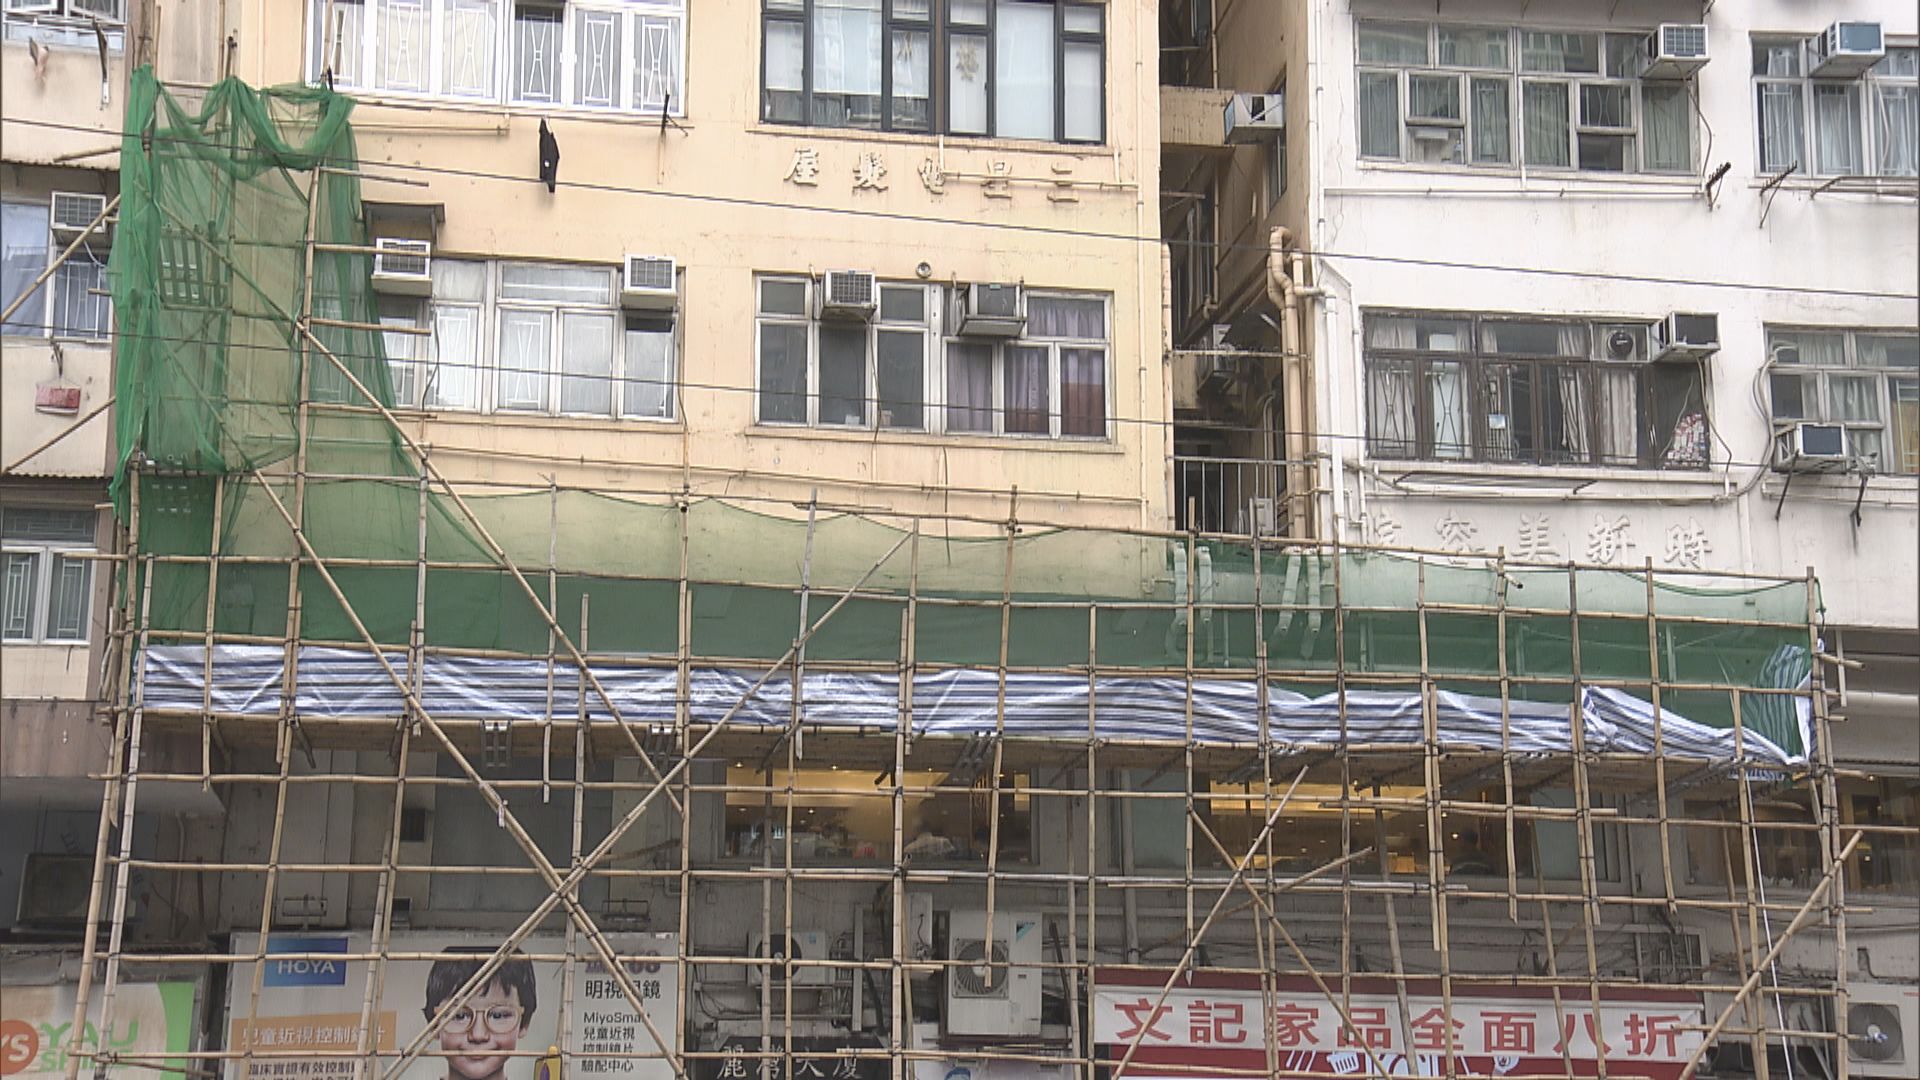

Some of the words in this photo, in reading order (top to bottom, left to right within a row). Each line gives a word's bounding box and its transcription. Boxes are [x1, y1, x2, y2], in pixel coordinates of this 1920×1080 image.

[277, 959, 336, 975] HOYA
[583, 1011, 651, 1025] MiyoSmat
[583, 1026, 636, 1041] 兒童近視
[1114, 997, 1682, 1057] 文記家品全面八折
